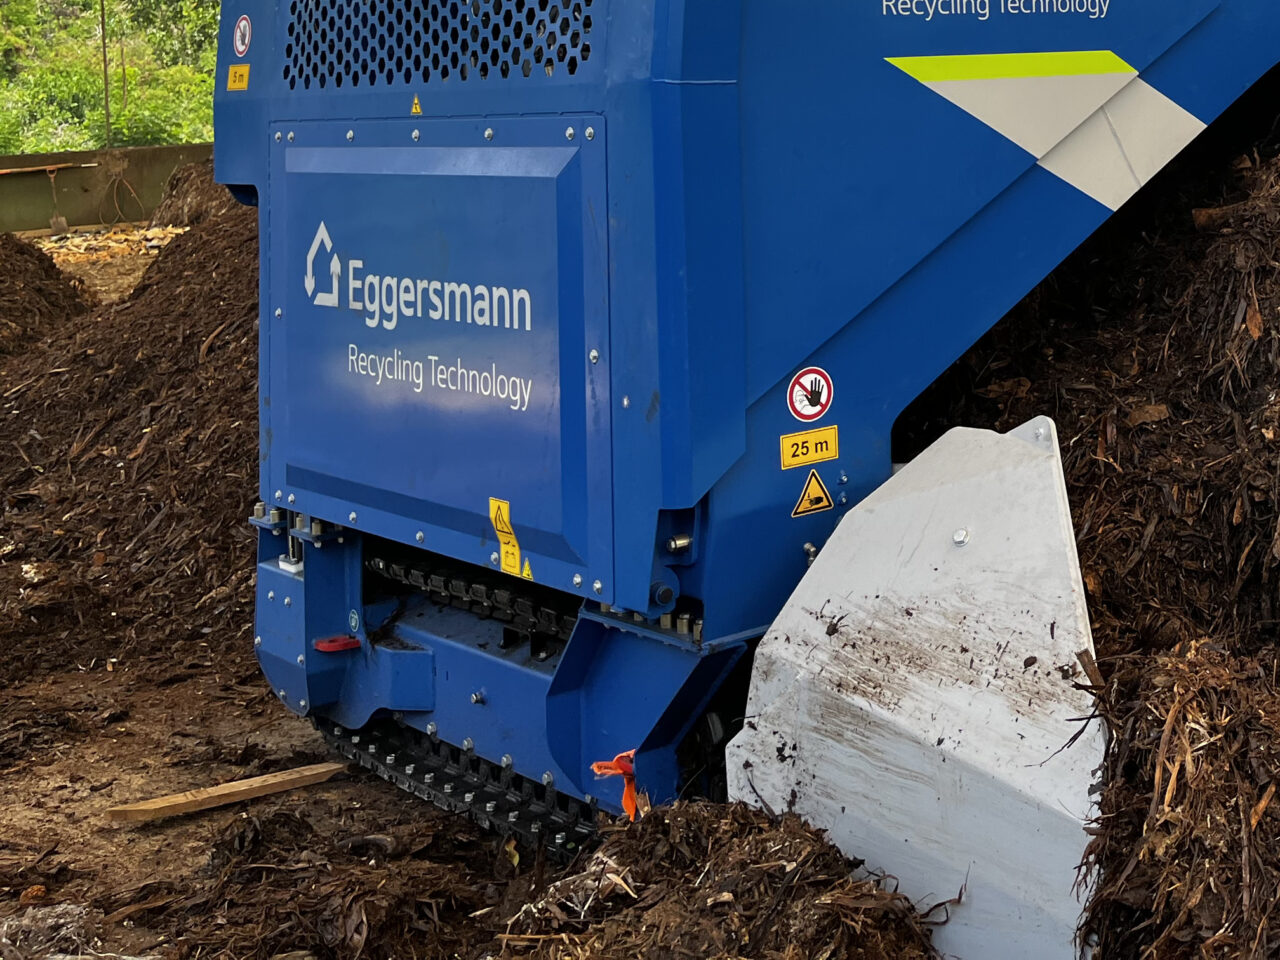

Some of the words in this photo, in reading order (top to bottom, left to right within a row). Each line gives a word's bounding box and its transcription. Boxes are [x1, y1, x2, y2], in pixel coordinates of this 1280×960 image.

[348, 258, 532, 331] Eggersmann
[348, 343, 423, 393] Recycling
[427, 355, 532, 412] Technology
[790, 440, 810, 458] 25
[815, 440, 828, 454] m
